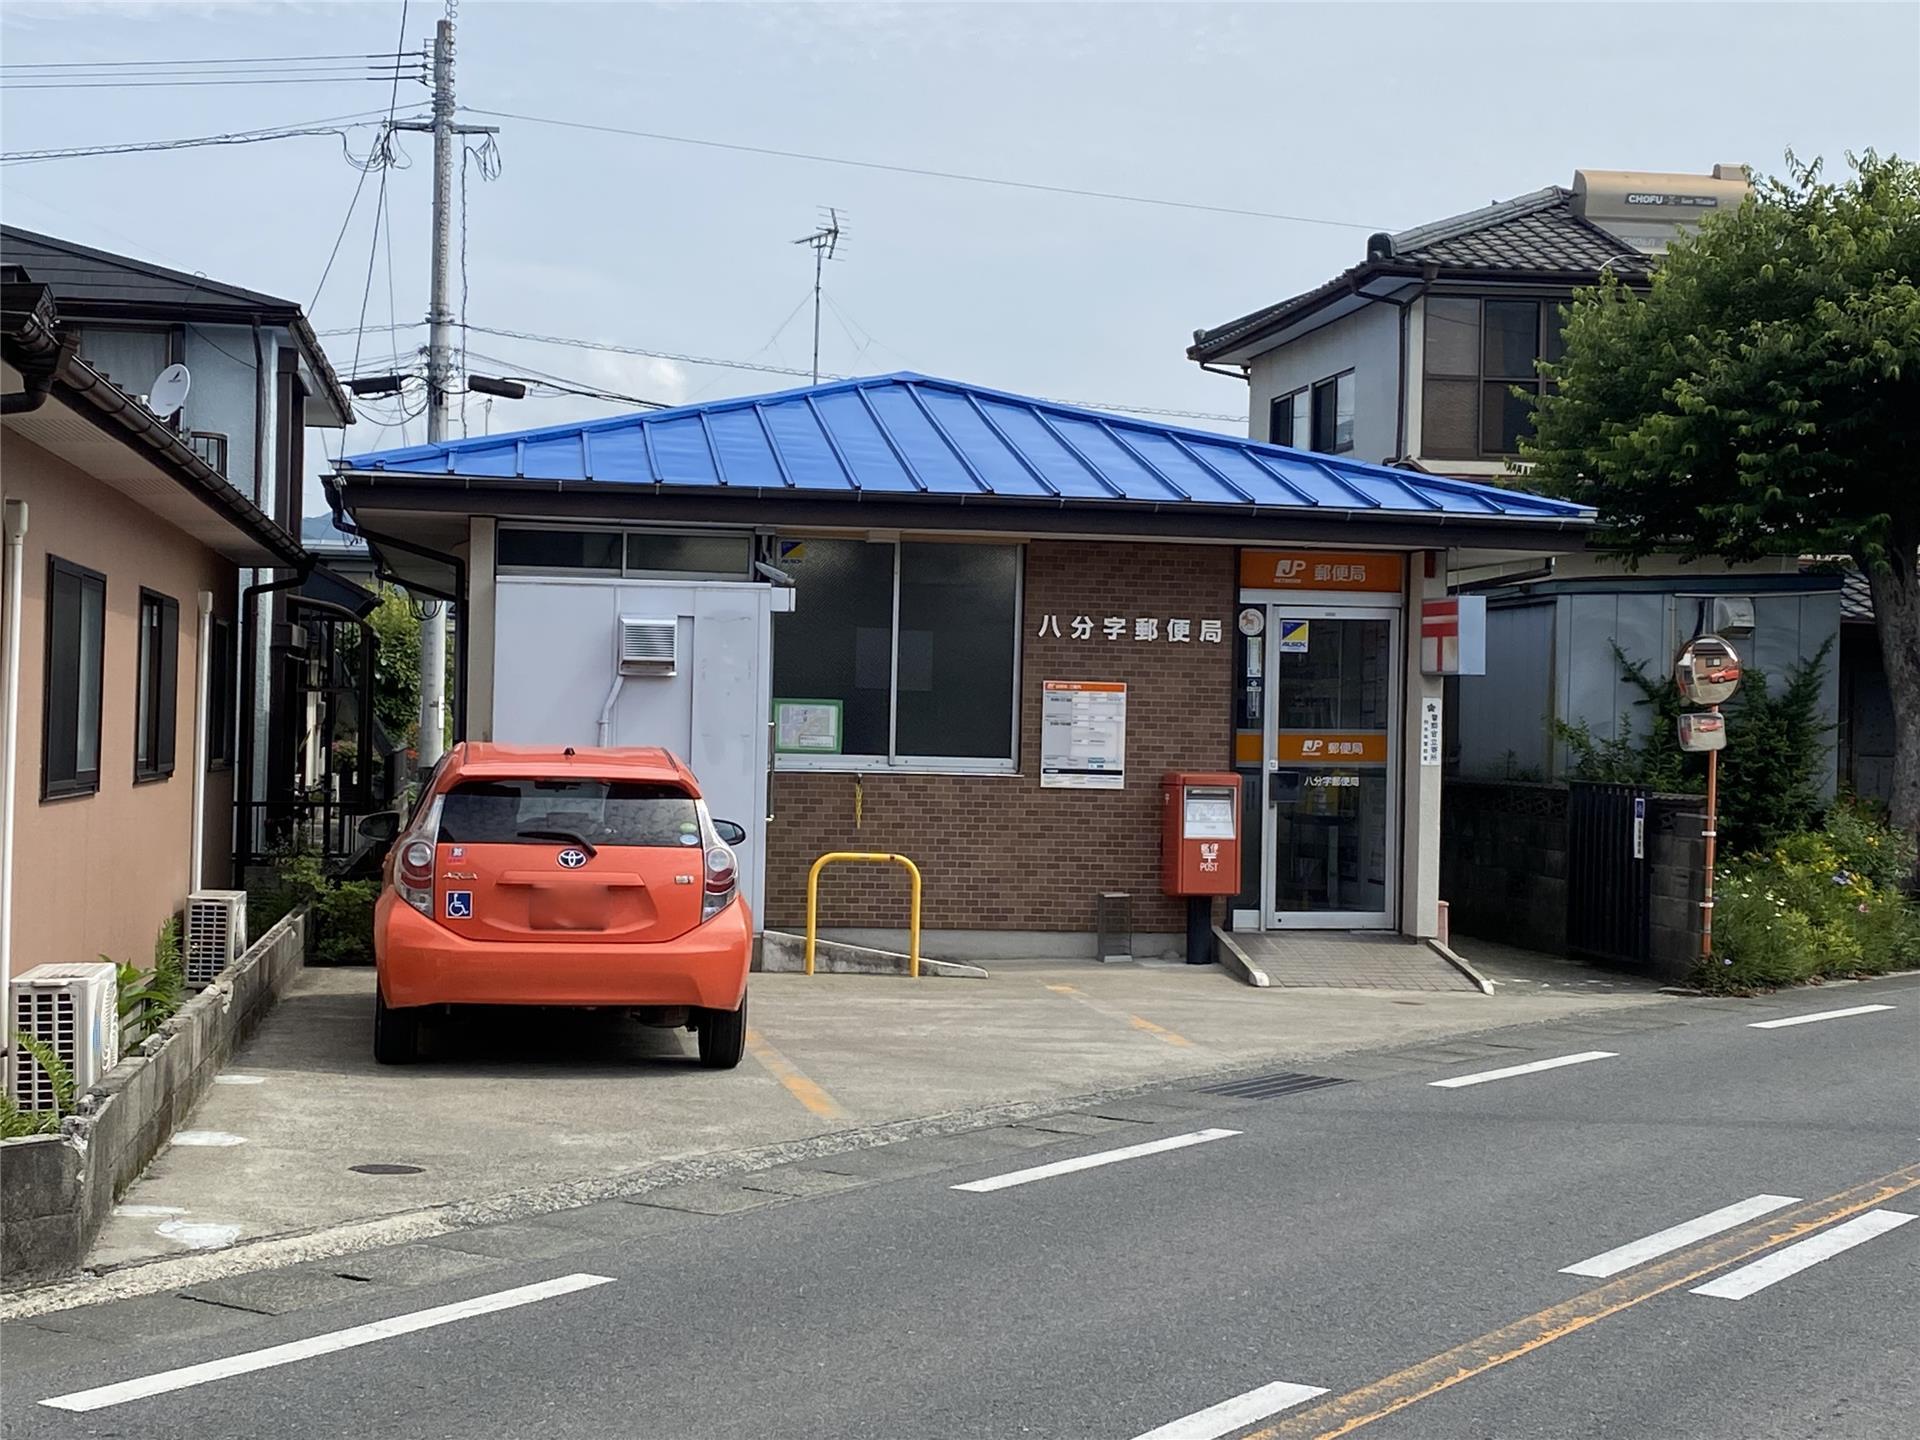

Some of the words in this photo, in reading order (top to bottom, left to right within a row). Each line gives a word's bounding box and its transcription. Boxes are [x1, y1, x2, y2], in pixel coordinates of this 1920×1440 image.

[1628, 194, 1664, 205] CHOFU
[1275, 559, 1307, 577] JP
[1314, 563, 1367, 583] 郵便局
[1038, 614, 1222, 643] 八分字郵便局
[1302, 740, 1324, 752] JP
[1327, 742, 1364, 755] 郵便局
[1303, 776, 1360, 787] 八分字郵便局
[1199, 862, 1218, 872] POST
